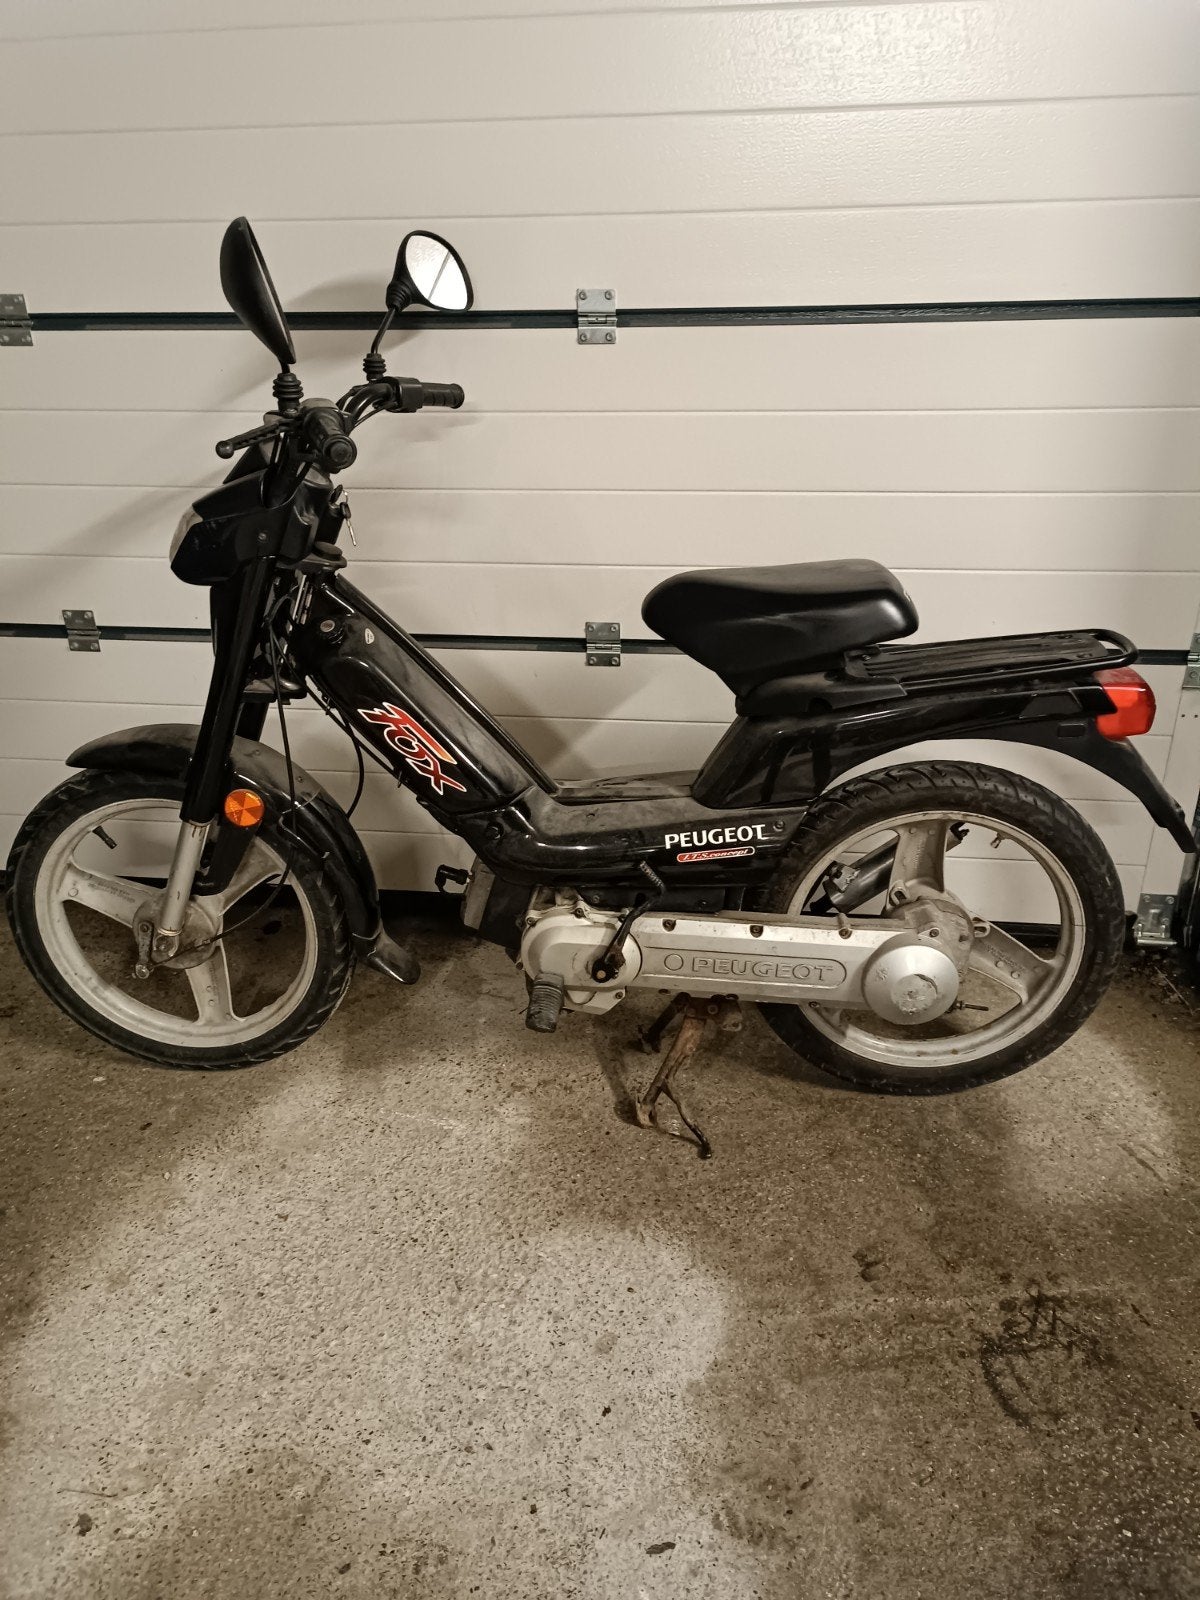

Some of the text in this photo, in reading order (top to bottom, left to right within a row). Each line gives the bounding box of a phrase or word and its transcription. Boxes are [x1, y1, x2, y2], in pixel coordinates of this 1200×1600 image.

[357, 701, 467, 796] FOX
[664, 824, 766, 850] PEUGEOT
[691, 957, 833, 981] PEUGEOT
